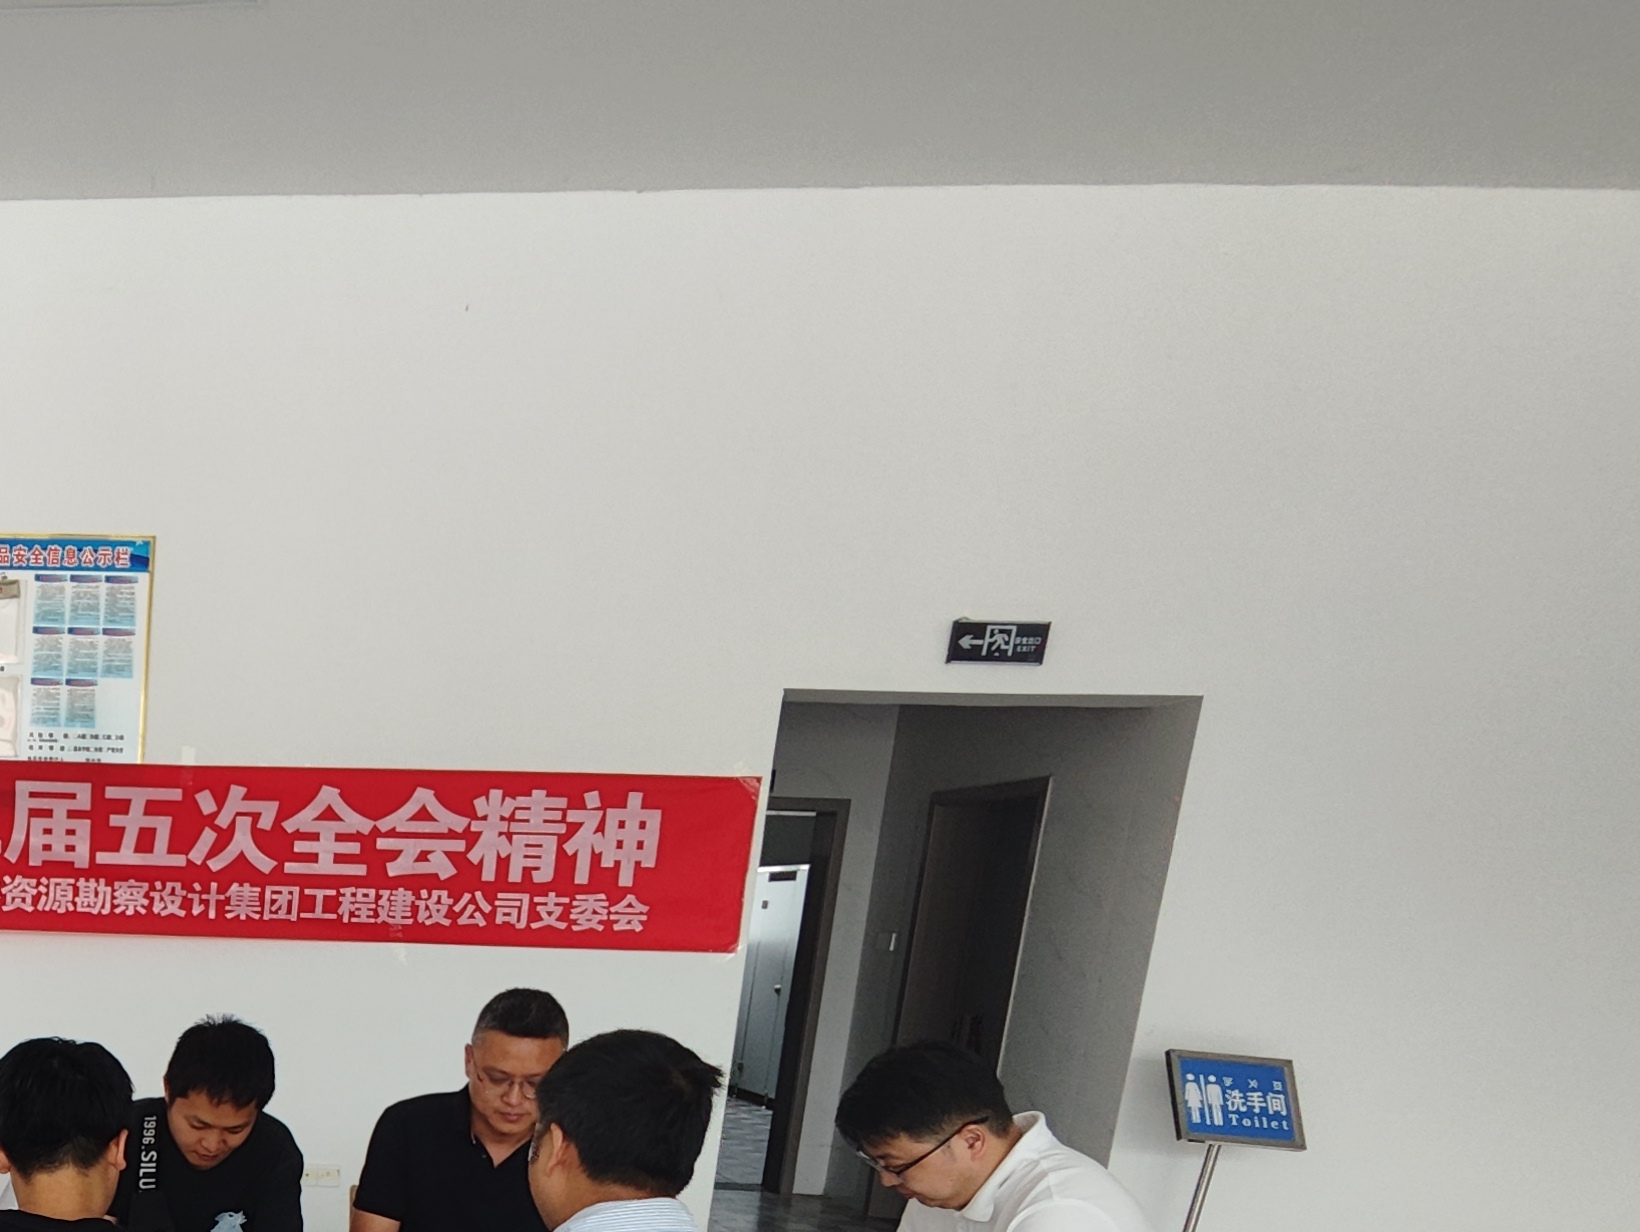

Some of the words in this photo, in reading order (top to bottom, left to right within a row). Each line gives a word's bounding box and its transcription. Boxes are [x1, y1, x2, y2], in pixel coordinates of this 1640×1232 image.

[1225, 1089, 1287, 1116] 洗手间
[1228, 1114, 1289, 1130] Toilet
